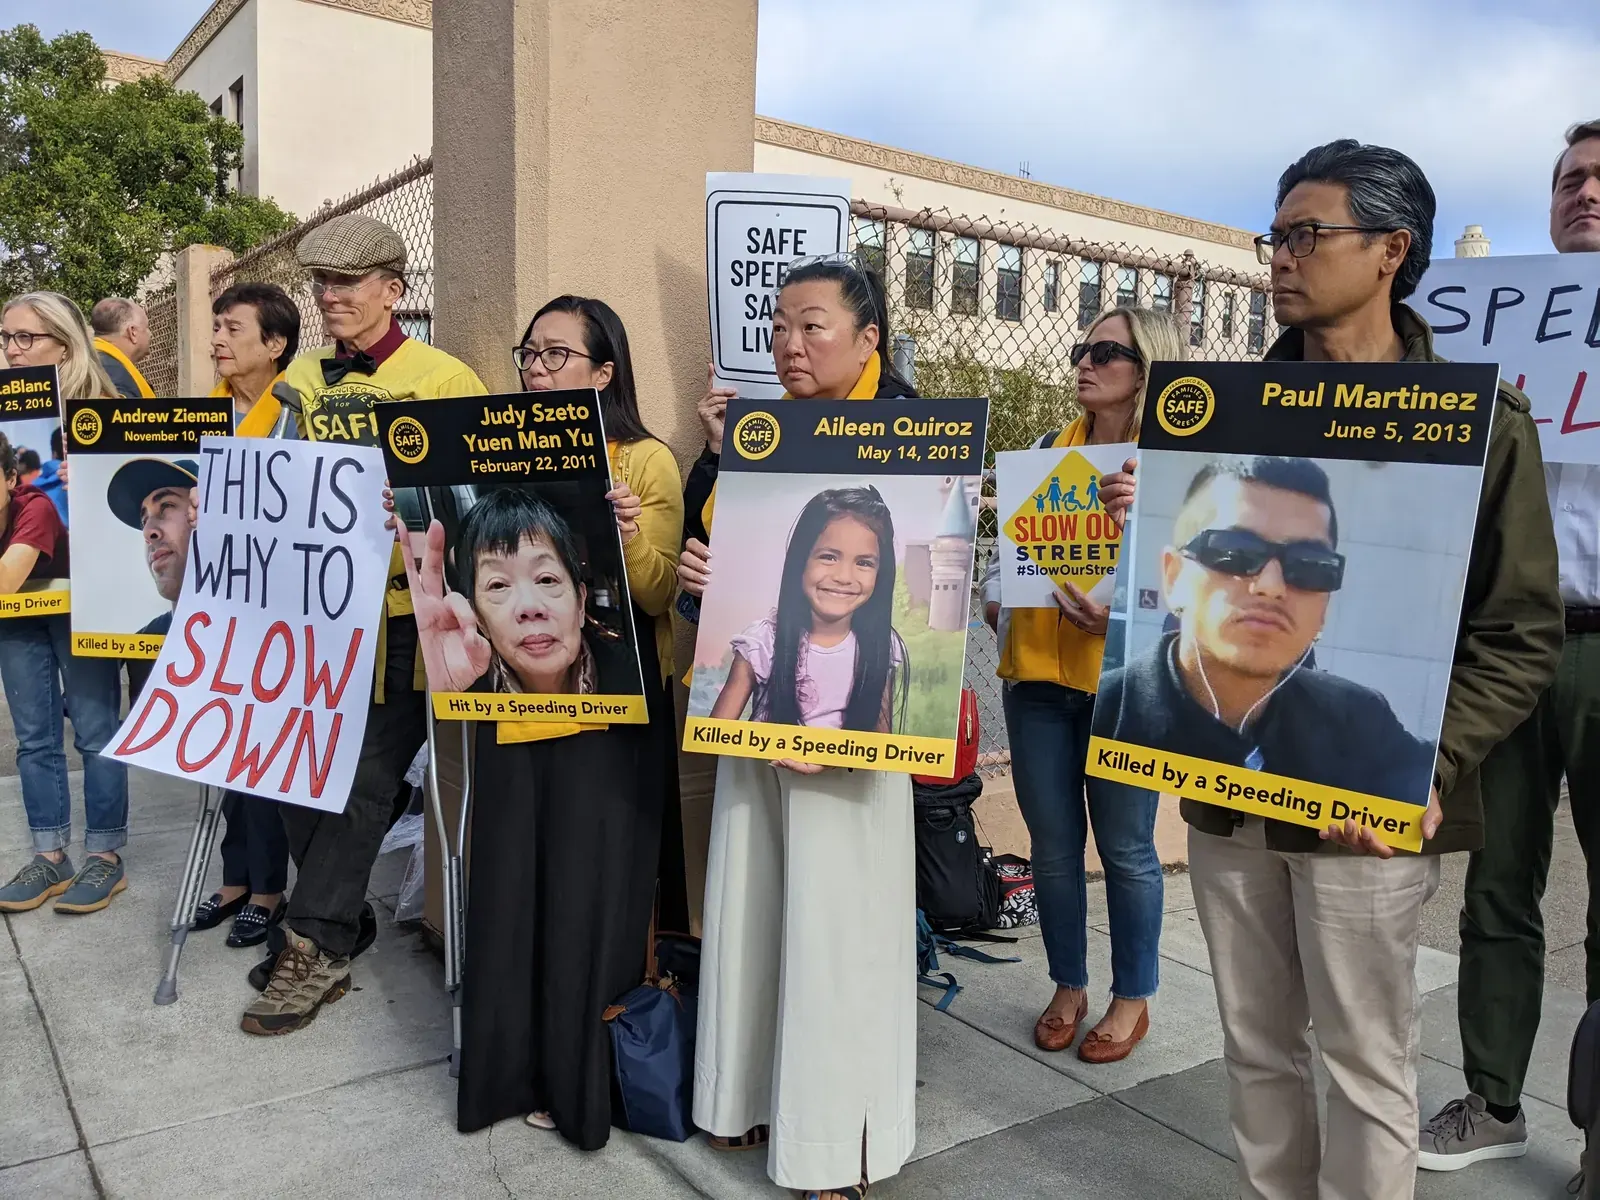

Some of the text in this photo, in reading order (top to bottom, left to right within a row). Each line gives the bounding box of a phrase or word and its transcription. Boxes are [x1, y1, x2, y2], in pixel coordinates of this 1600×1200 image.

[746, 226, 808, 256] SAFE
[0, 379, 51, 395] aBlanc
[1169, 378, 1197, 390] FRANCISCO
[1171, 386, 1204, 400] FAMILIES
[5, 401, 22, 412] 25,
[25, 397, 53, 410] 2016
[1261, 382, 1478, 411] Paul Martinez
[1166, 399, 1205, 414] SAFE
[111, 408, 168, 424] Andrew
[172, 408, 228, 423] Zieman
[480, 403, 590, 429] Judy Szeto
[744, 419, 772, 430] FAMILIES
[1168, 414, 1200, 427] STREETS
[77, 422, 97, 431] SAFE
[813, 416, 973, 437] Aileen Quiroz
[1323, 420, 1472, 443] June 5, 2013
[124, 430, 179, 442] November
[181, 430, 199, 443] 10,
[395, 434, 422, 447] SAFE
[462, 428, 594, 452] Yuen Man Yu
[741, 430, 772, 442] SAFE
[743, 442, 769, 452] STREETS
[857, 445, 970, 464] May 14, 2013
[470, 454, 596, 475] February 22, 2011
[202, 447, 365, 534] THIS IS
[1014, 514, 1078, 543] SLOW
[1016, 543, 1119, 562] STREET
[192, 529, 354, 621] WHY TO
[1016, 564, 1117, 576] #SlowOurStre
[25, 597, 62, 609] Driver
[77, 638, 108, 650] Killed
[112, 640, 125, 653] by
[129, 643, 135, 651] a
[166, 611, 364, 709] SLOW
[449, 699, 629, 717] Hit by a Speeding Driver
[113, 688, 343, 799] DOWN
[693, 726, 945, 765] Killed by a Speeding Driver
[1097, 748, 1411, 835] Killed by a Speeding Driver
